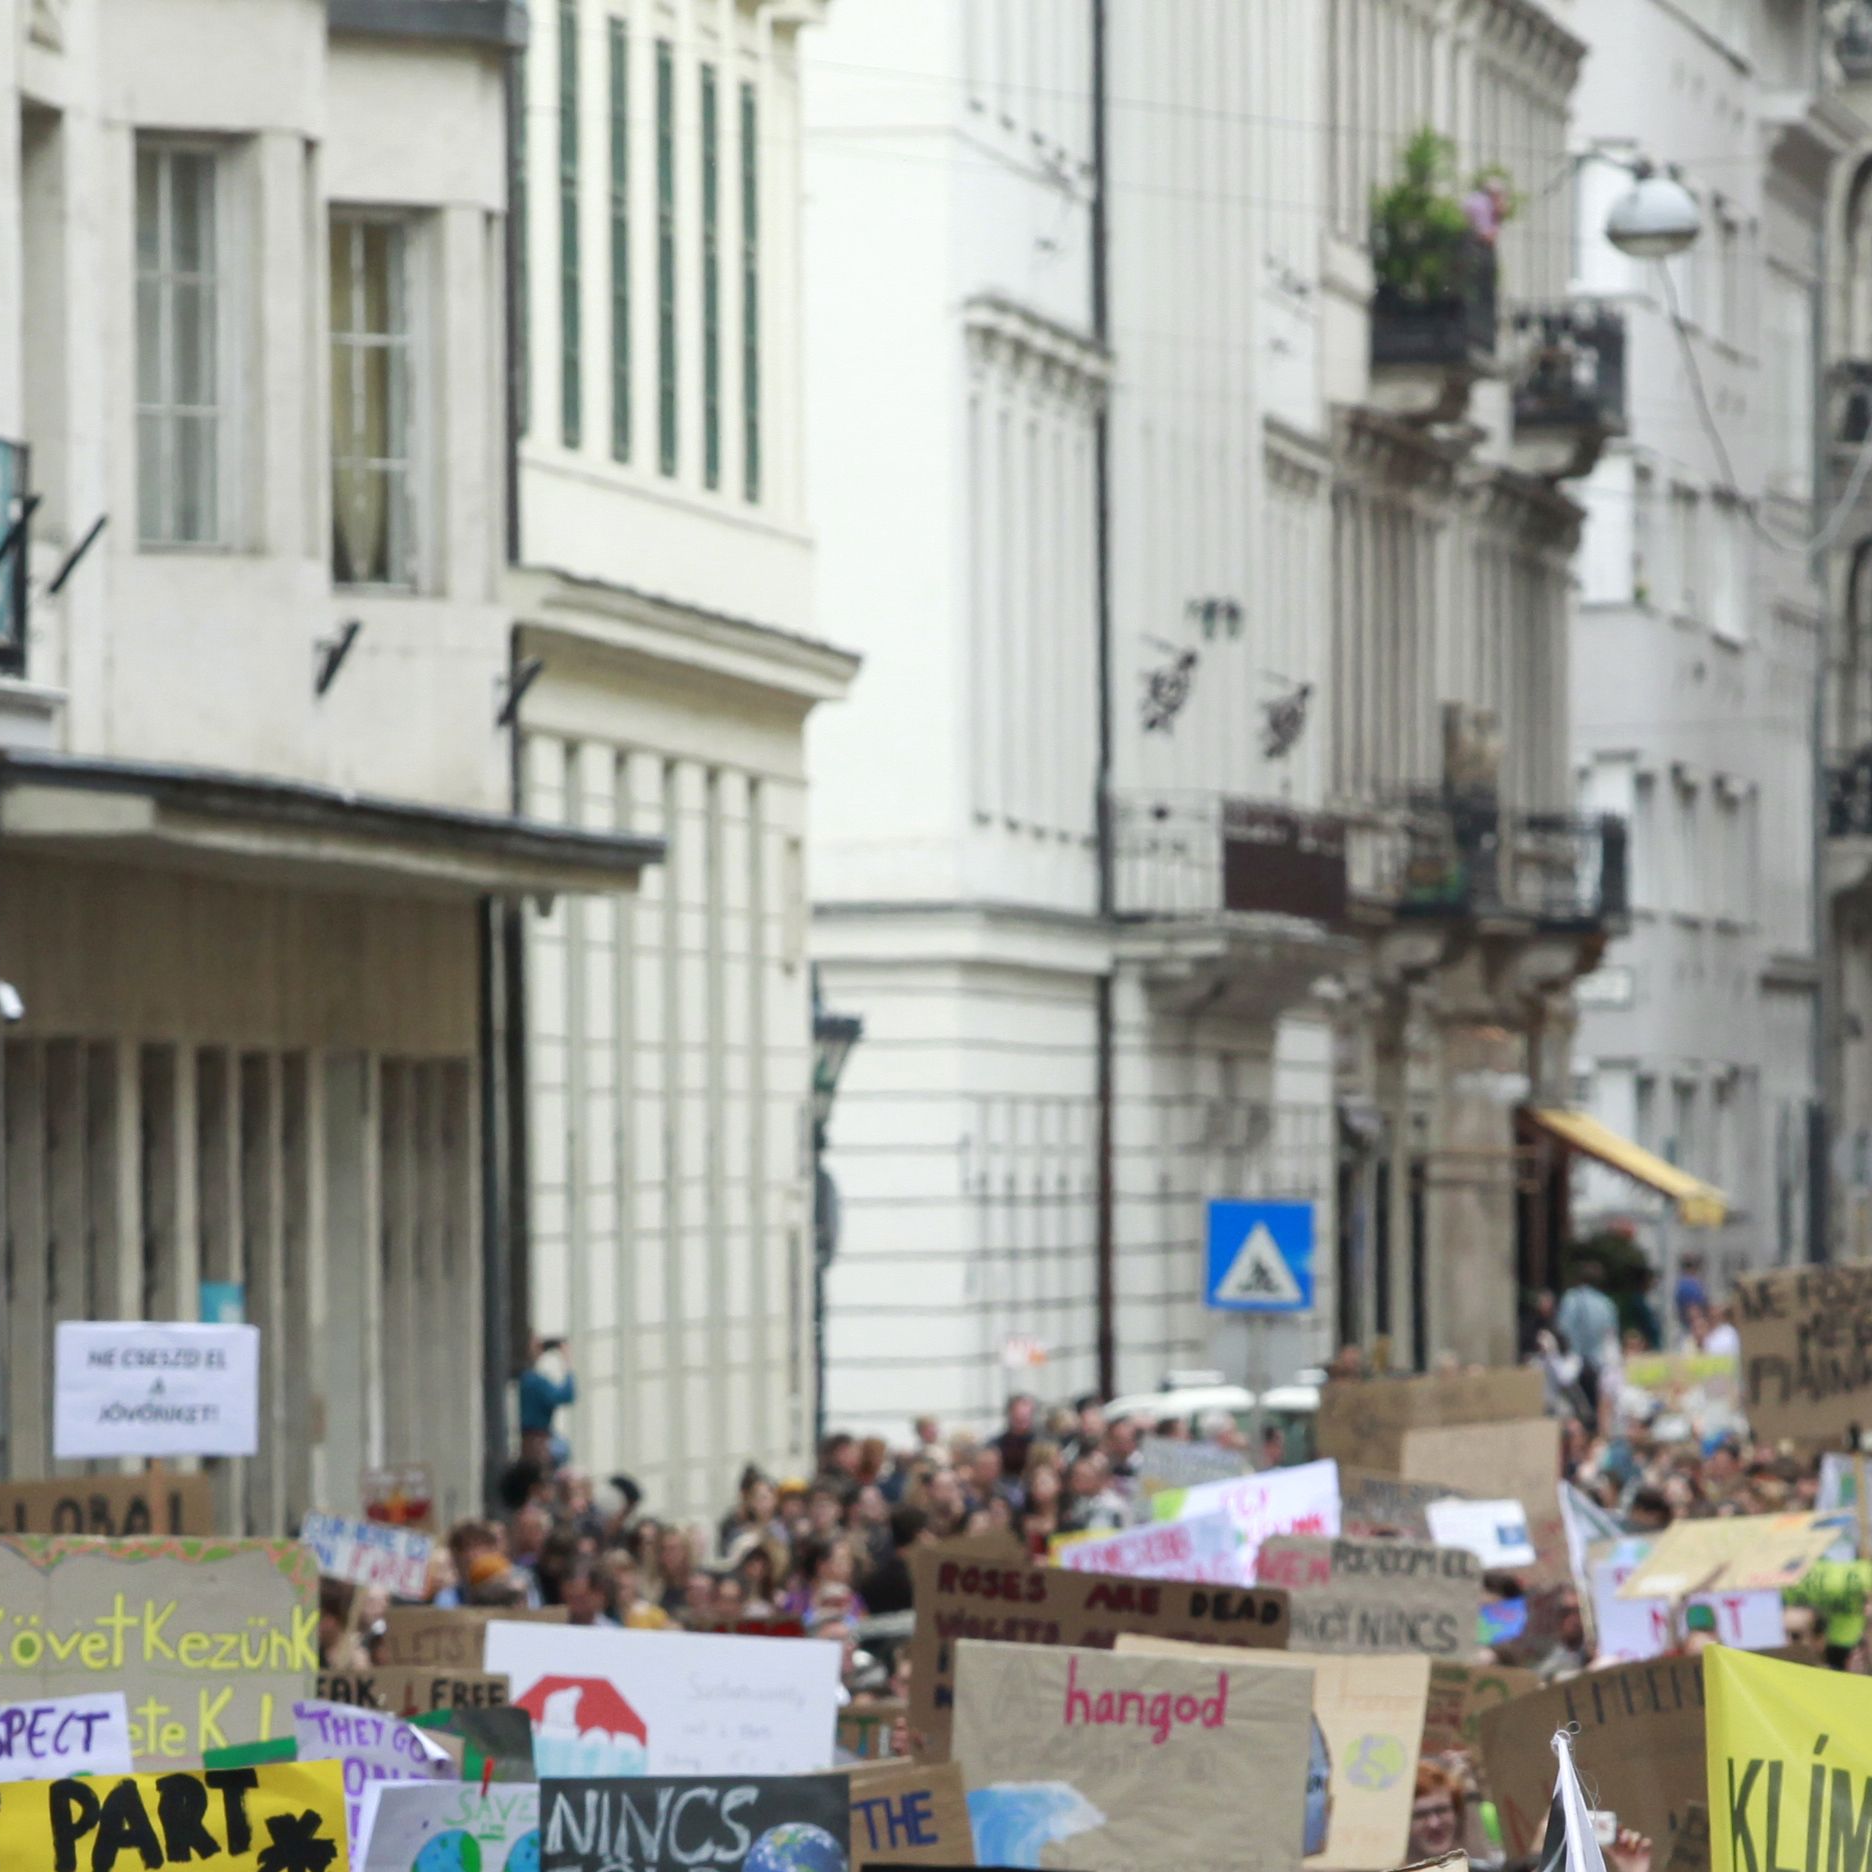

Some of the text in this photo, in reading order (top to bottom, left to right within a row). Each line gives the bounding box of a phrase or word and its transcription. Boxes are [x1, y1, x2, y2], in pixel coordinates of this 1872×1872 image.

[938, 1561, 1281, 1626] ROSES ARE DEAD
[1063, 1656, 1230, 1744] hangod
[544, 1785, 760, 1866] NINCS
[850, 1789, 939, 1851] THE
